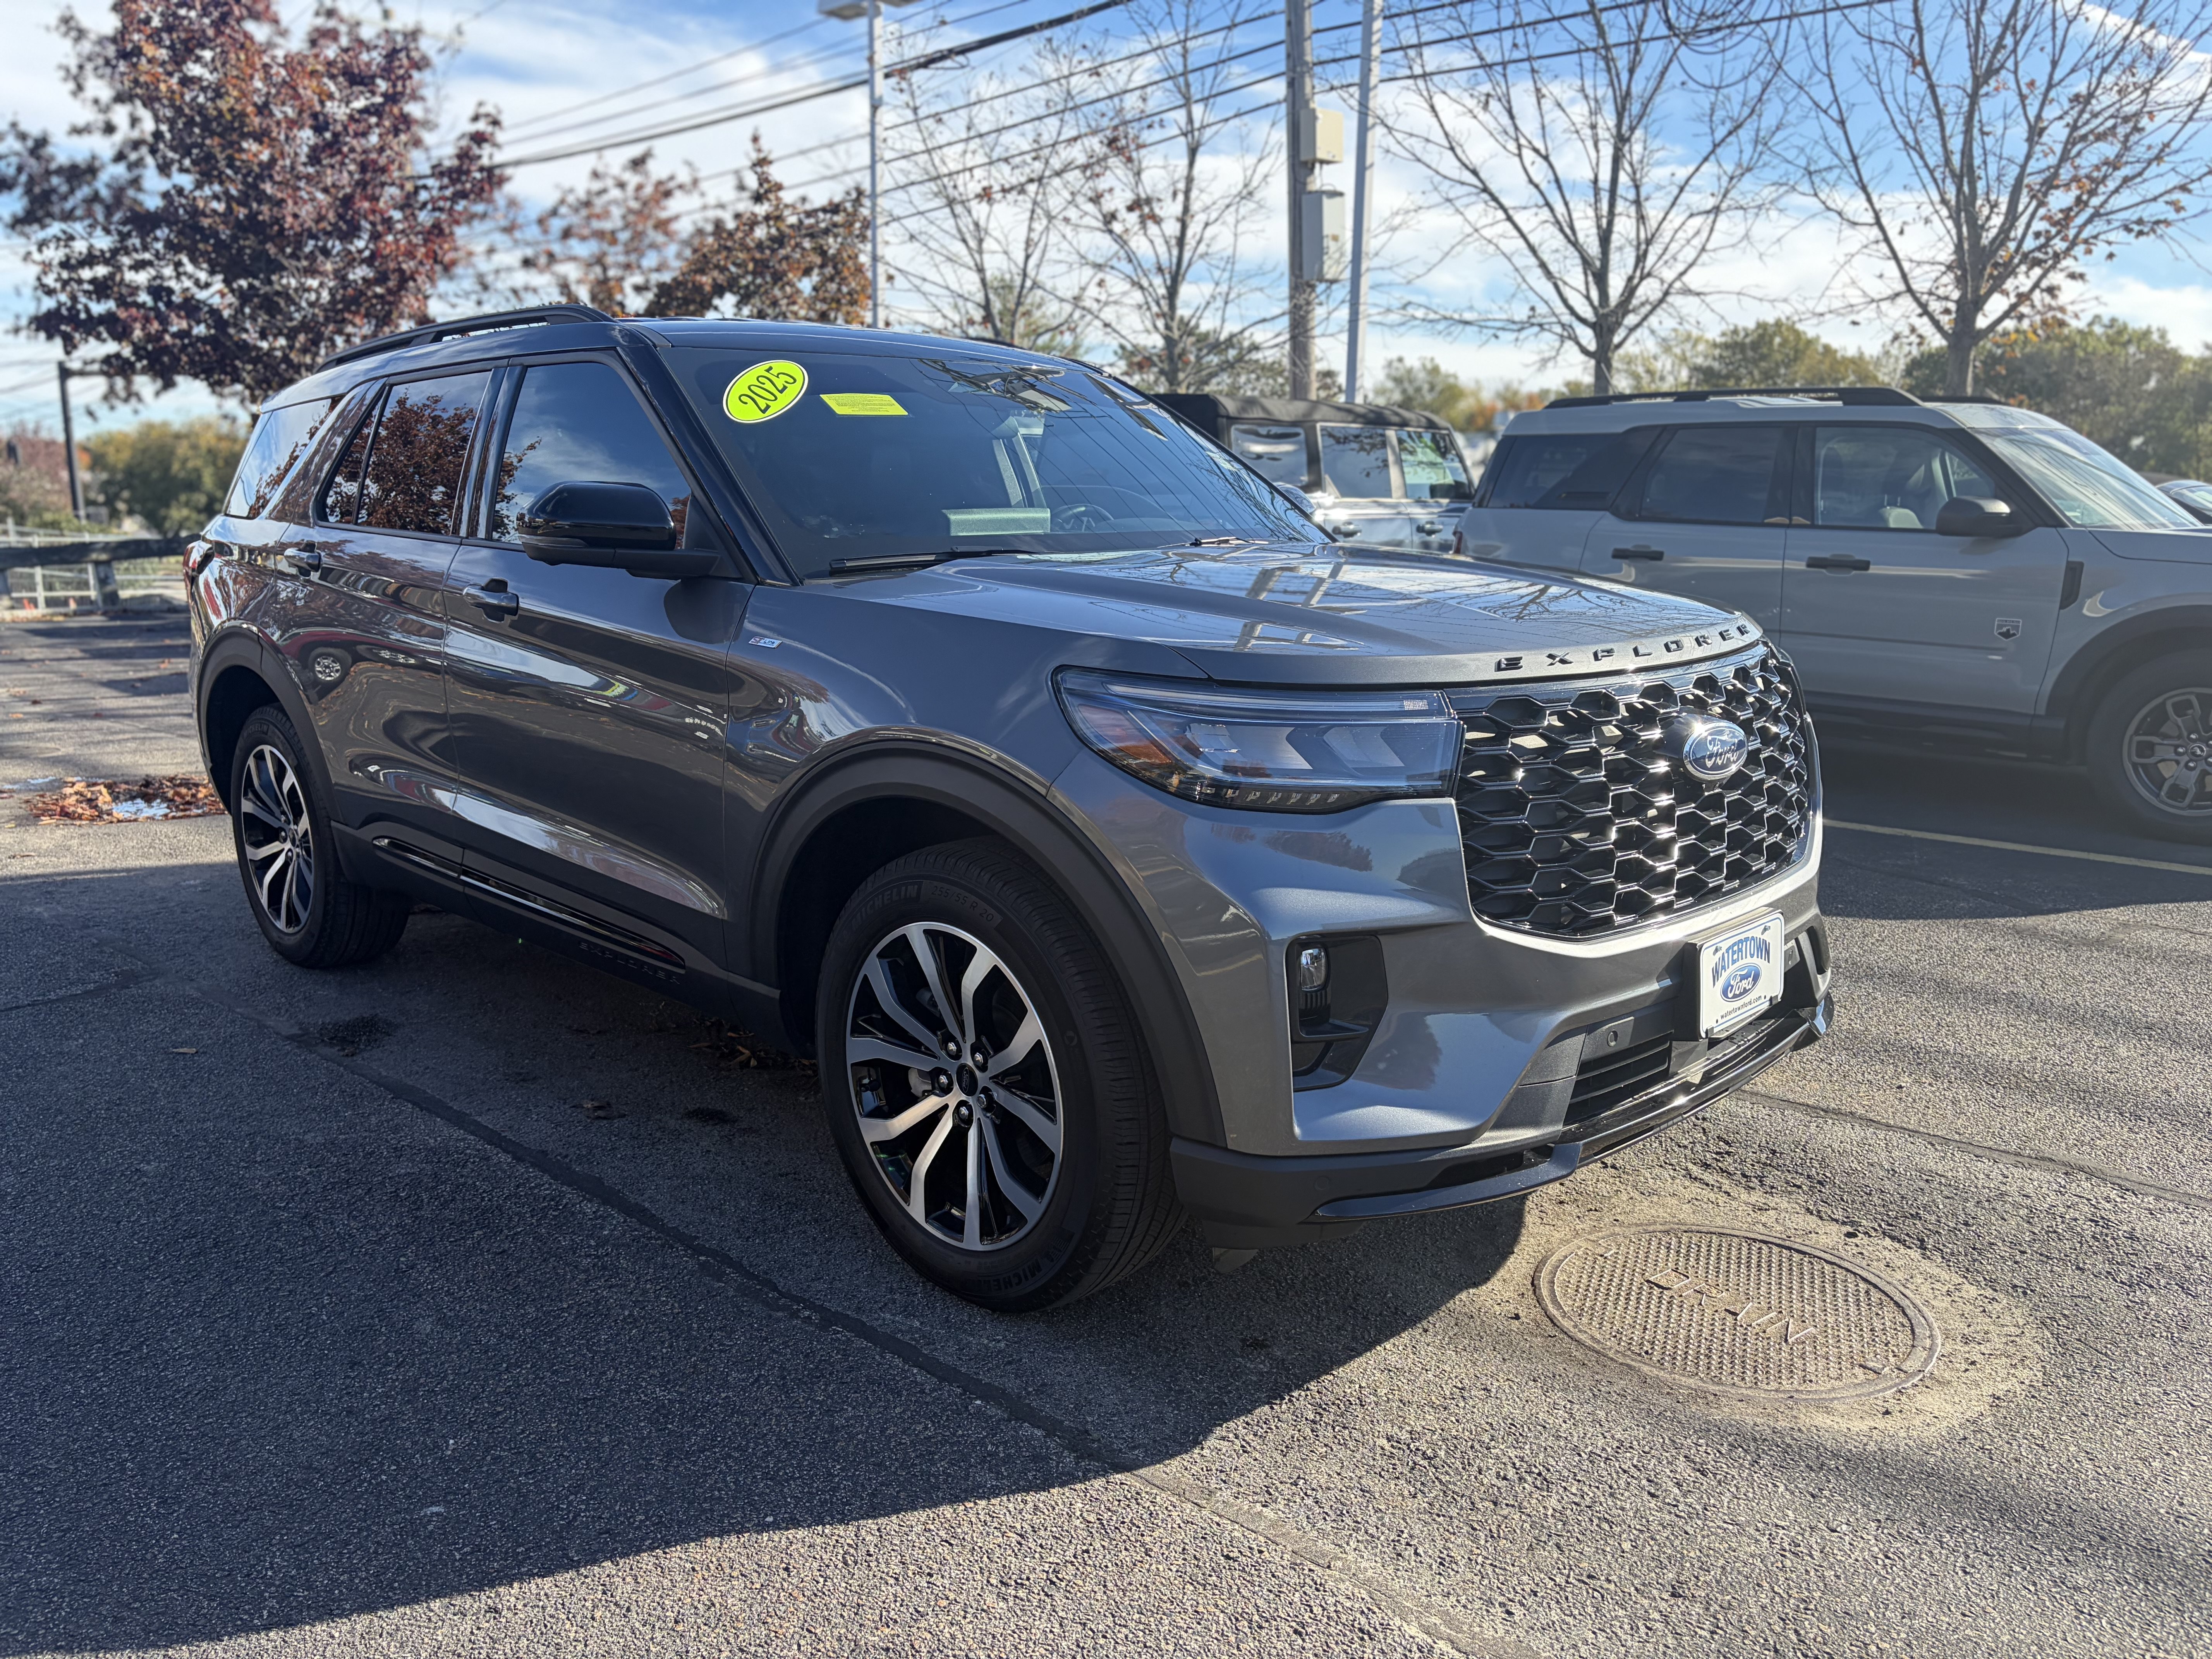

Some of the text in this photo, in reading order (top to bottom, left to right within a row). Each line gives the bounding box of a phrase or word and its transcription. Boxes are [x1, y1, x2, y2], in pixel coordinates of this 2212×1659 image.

[738, 366, 797, 414] 2025
[1494, 624, 1750, 672] EXPLORER
[1705, 734, 1739, 768] Ford
[852, 885, 994, 931] MICHELIN 255/55 R 20
[578, 941, 680, 985] EXPLORER
[1711, 936, 1771, 989] WATERTOWN
[1728, 968, 1755, 998] Ford
[1720, 995, 1762, 1020] watertownford.com
